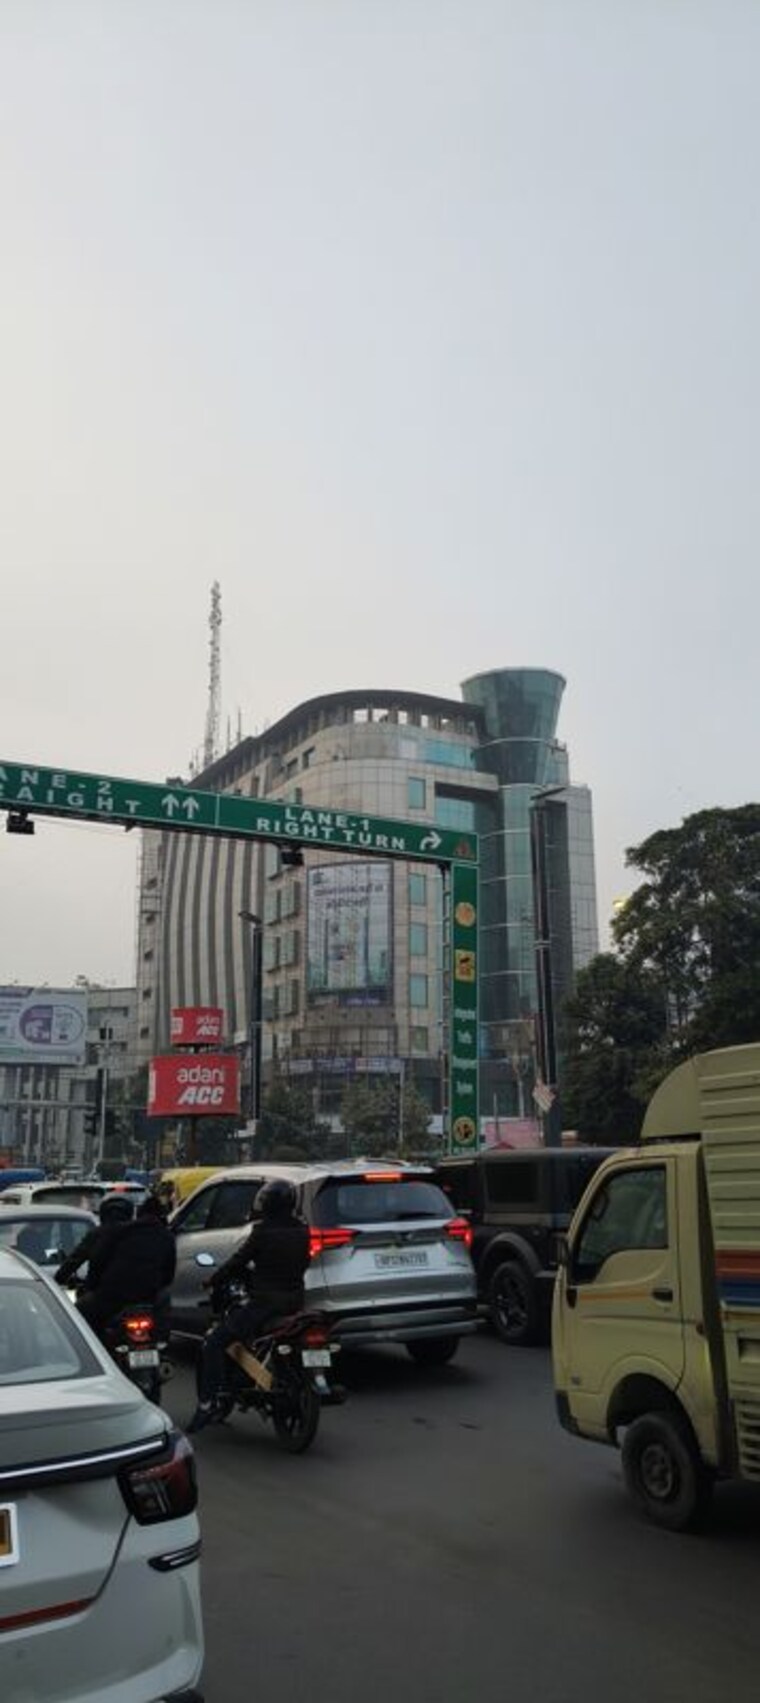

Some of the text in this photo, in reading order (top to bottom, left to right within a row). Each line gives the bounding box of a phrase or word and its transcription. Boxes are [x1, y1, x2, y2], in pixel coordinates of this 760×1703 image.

[0, 784, 140, 814] AIGHT
[285, 808, 369, 831] LANE-1
[256, 818, 405, 850] RIGHT TURN
[176, 1065, 225, 1083] adani
[178, 1086, 225, 1105] ACC
